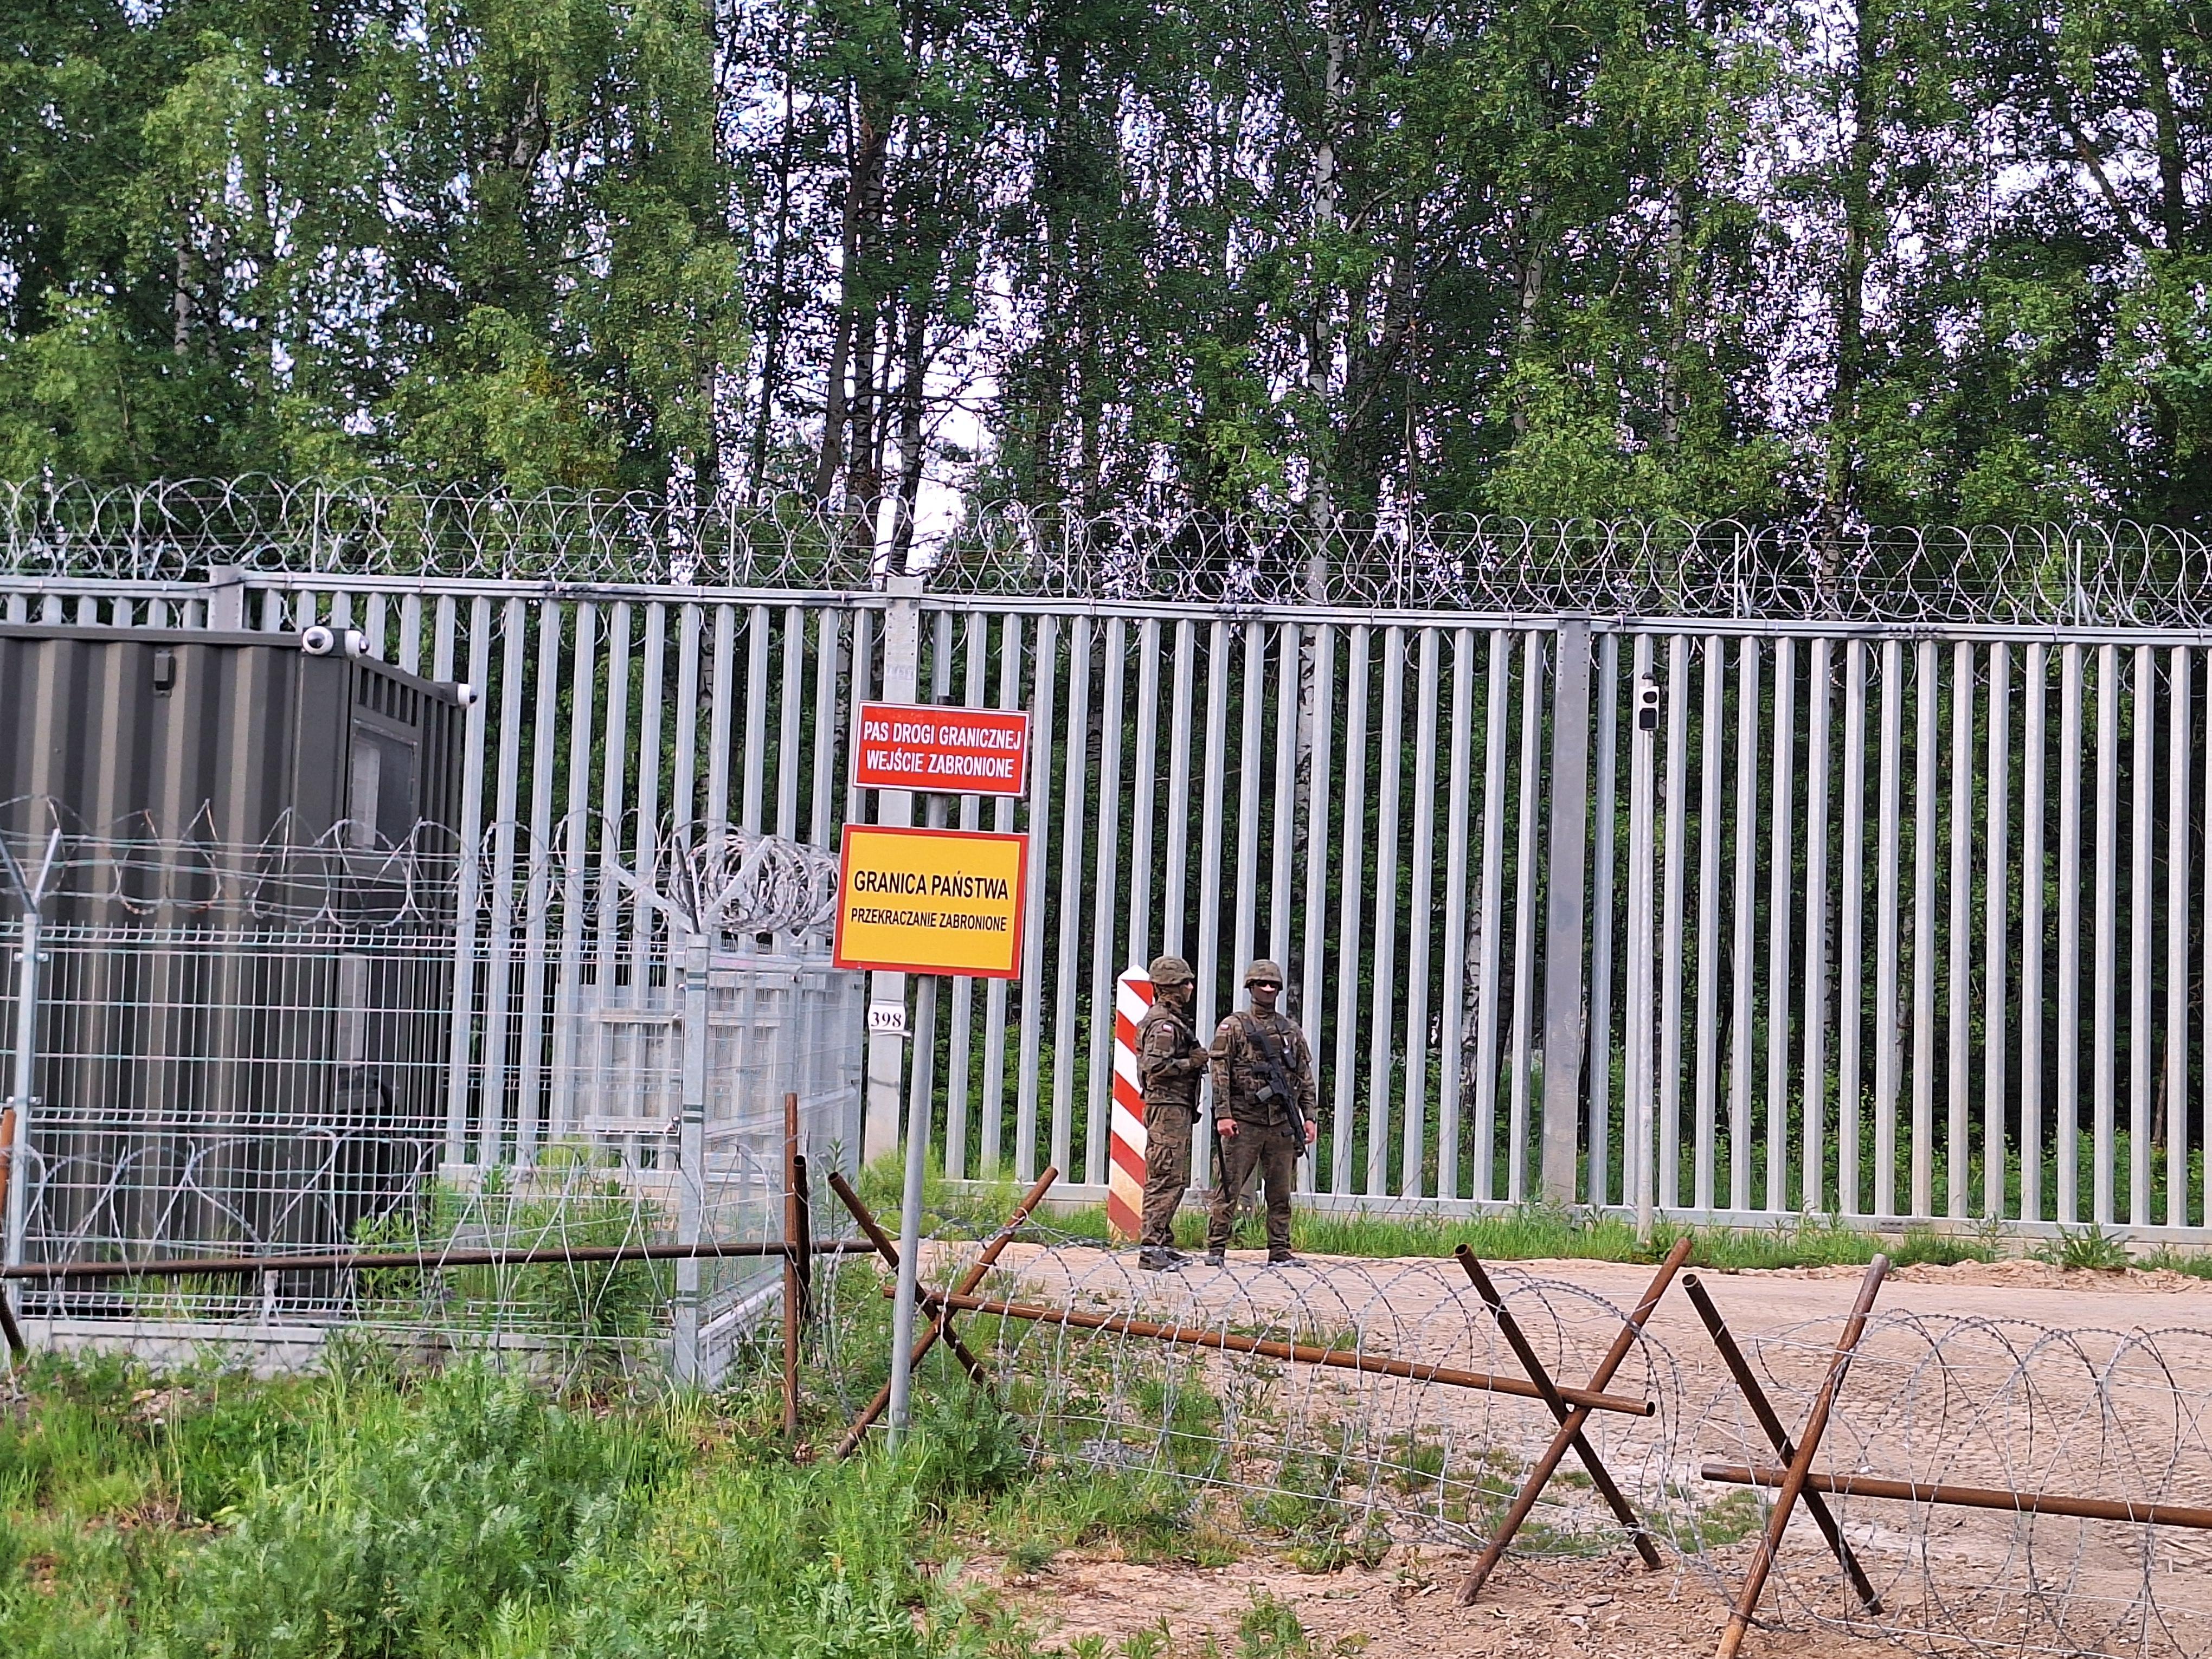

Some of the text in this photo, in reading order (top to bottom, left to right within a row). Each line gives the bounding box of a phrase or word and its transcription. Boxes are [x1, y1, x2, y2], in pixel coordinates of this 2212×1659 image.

[864, 721, 1021, 750] PAS DROGI GRANICZNEJ
[866, 747, 1015, 778] WEJŚCIE ZABRONIONE
[854, 870, 1008, 900] GRANICA PAŃSTWA
[851, 908, 1008, 931] PRZEKRACZANIE ZABRONIONE
[871, 1012, 902, 1028] 398
